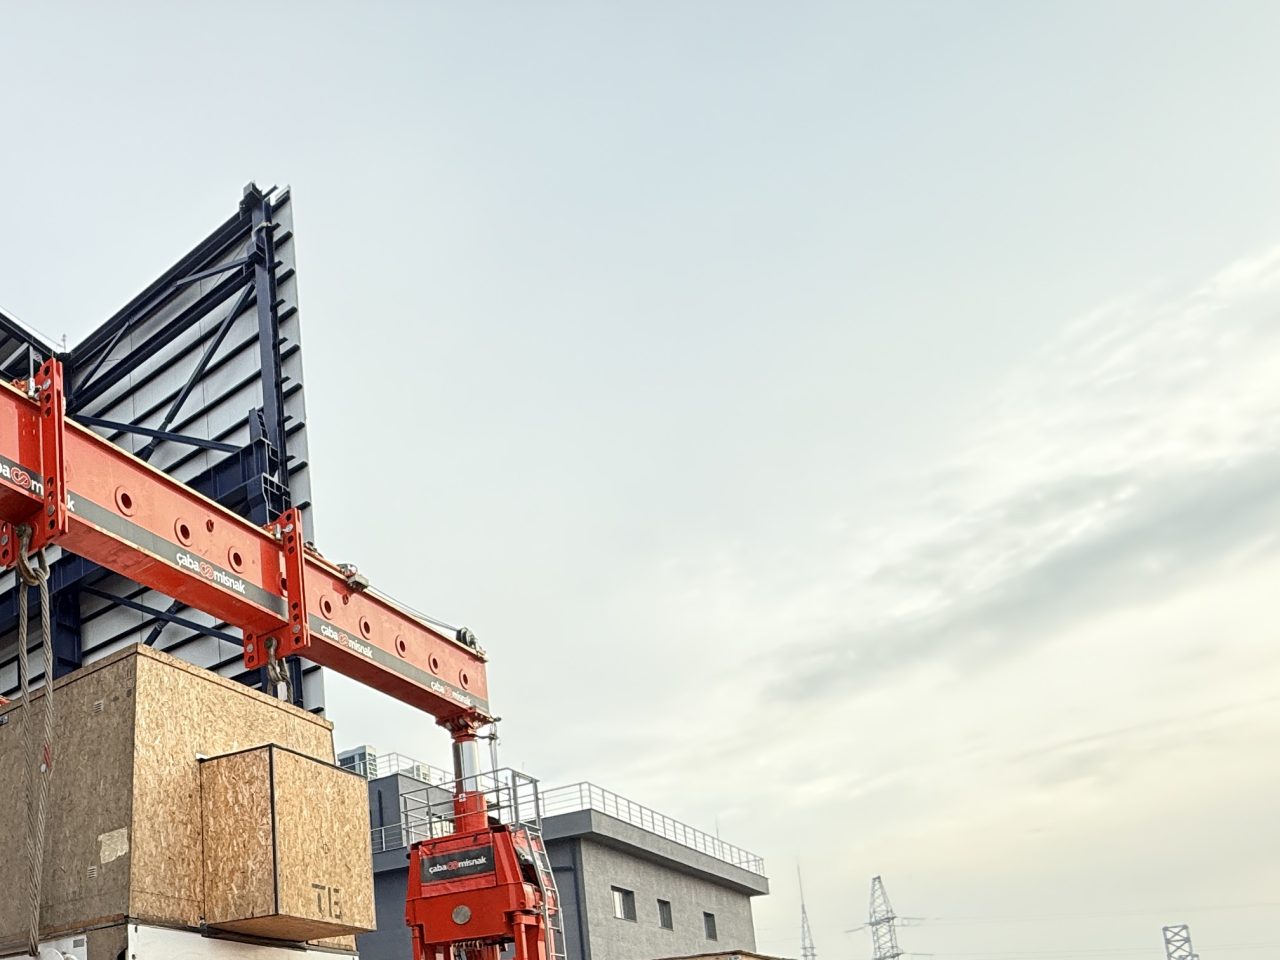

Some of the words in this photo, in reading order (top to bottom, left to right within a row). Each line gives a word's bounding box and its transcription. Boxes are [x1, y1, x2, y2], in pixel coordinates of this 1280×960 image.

[176, 552, 200, 571] çaba
[213, 571, 246, 595] misnak
[428, 863, 447, 875] çaba
[458, 855, 487, 868] misnak
